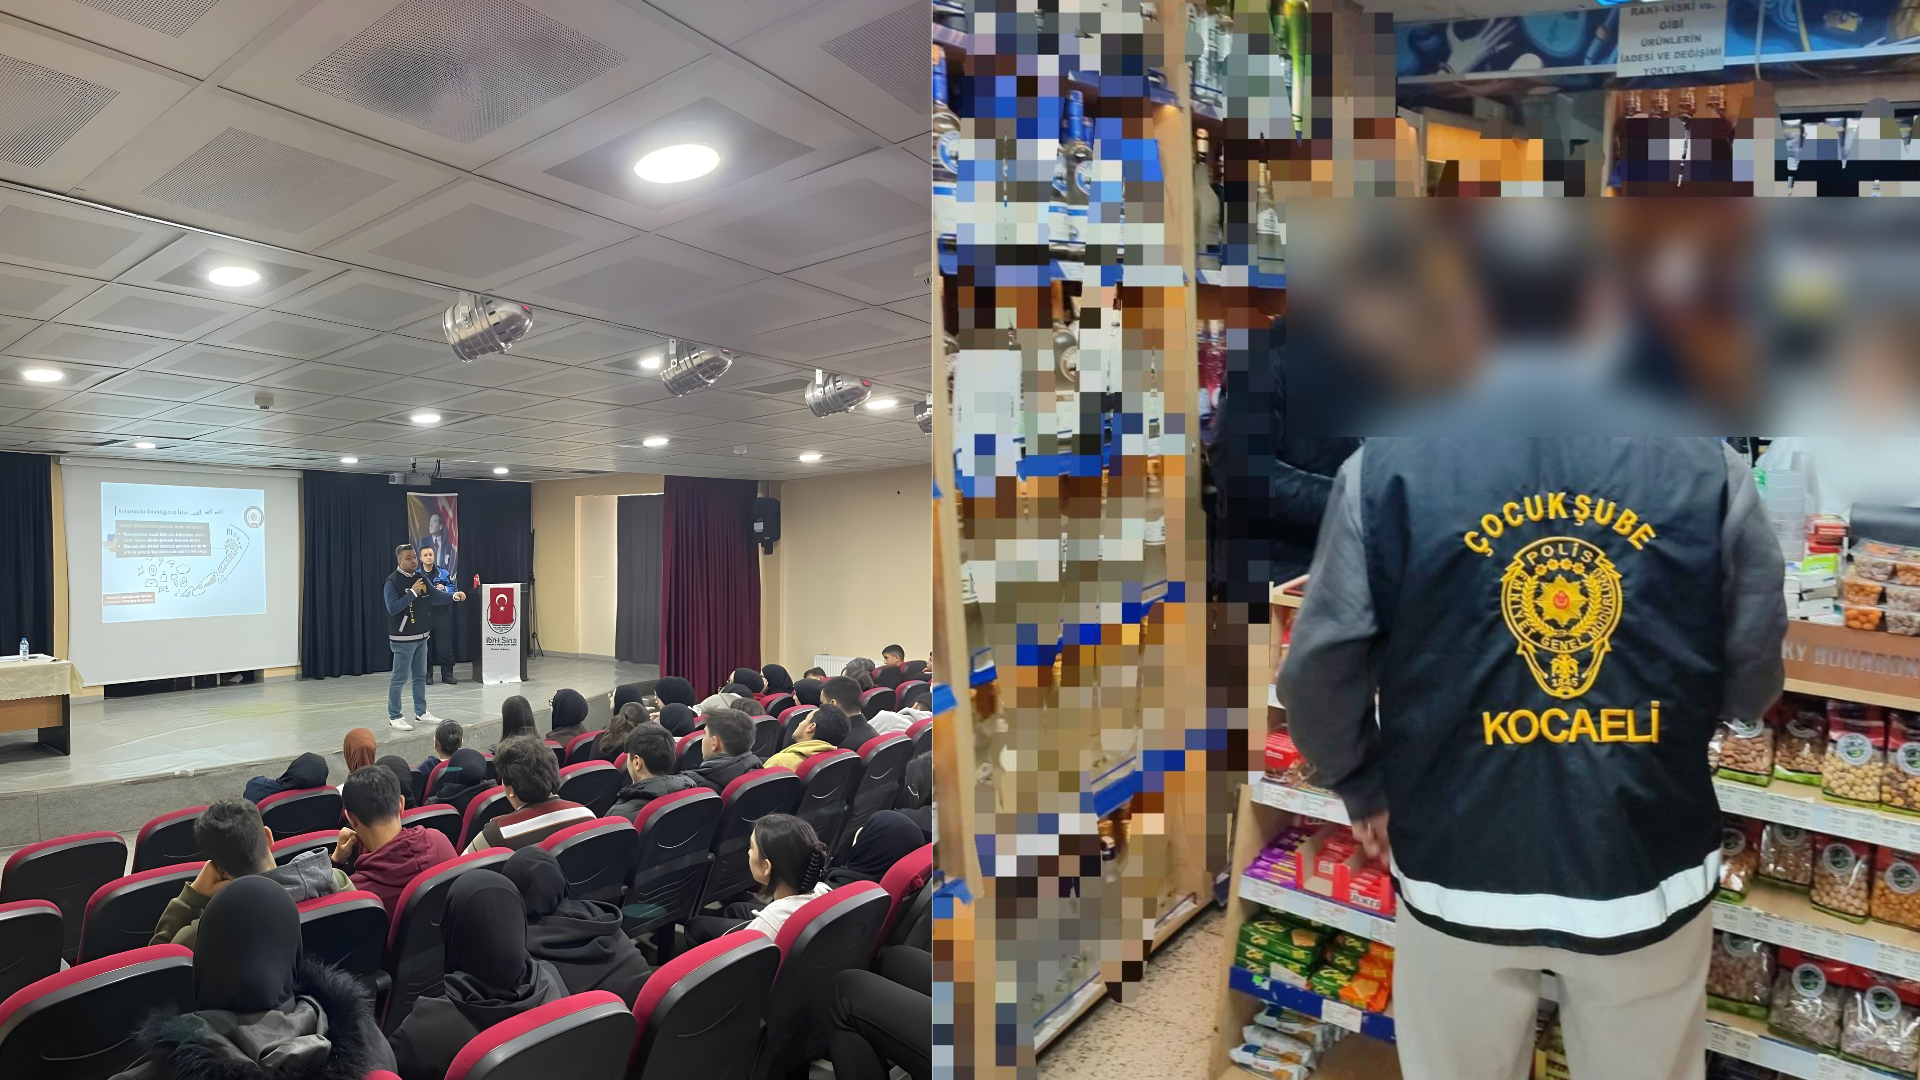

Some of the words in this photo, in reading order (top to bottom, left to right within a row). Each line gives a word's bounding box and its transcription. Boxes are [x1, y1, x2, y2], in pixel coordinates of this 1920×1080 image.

[1658, 18, 1684, 30] GİBİ
[1641, 34, 1702, 47] ÜRÜNLERİN
[1620, 52, 1654, 63] İADESİ
[1657, 51, 1670, 60] VE
[1526, 542, 1594, 565] POLİS
[1541, 635, 1587, 651] GENEL
[1781, 639, 1807, 662] KY
[1482, 701, 1661, 745] KOCAELİ
